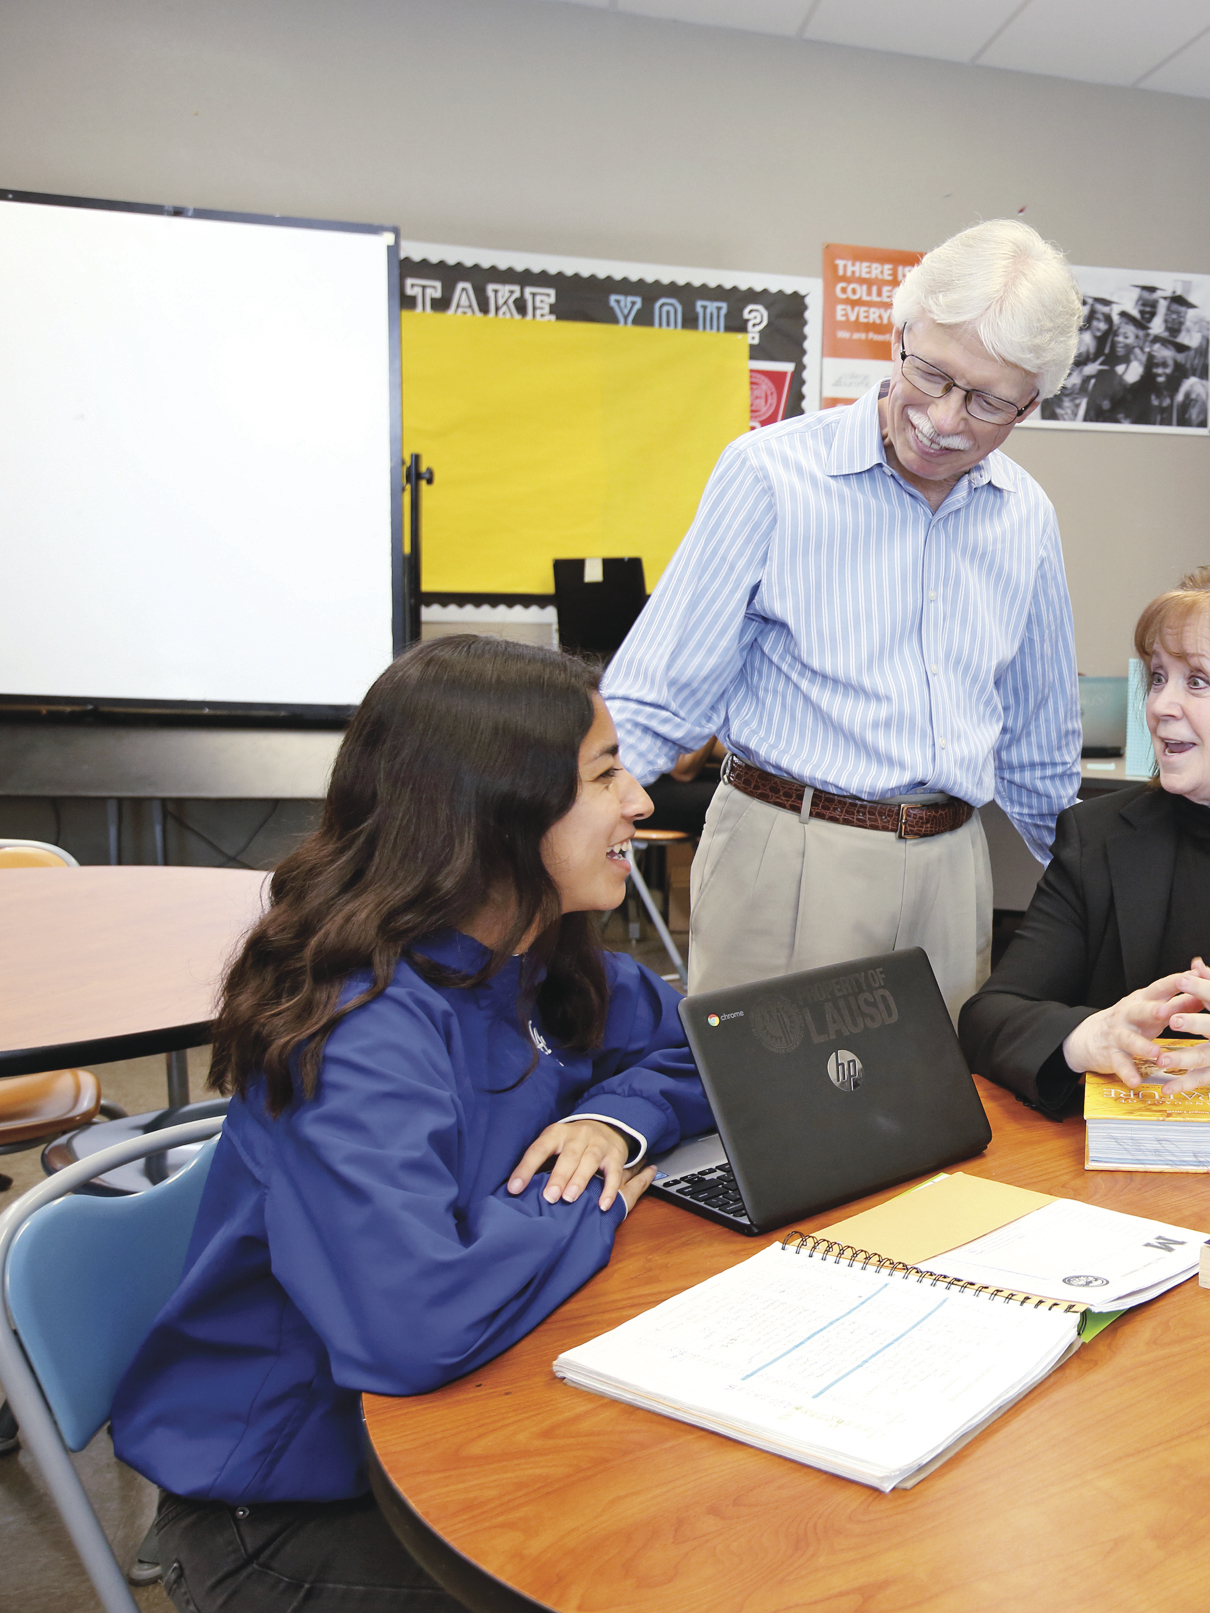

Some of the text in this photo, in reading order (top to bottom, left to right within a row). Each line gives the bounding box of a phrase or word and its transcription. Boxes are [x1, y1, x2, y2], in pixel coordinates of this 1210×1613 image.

[835, 259, 893, 280] THERE
[405, 278, 556, 322] TAKE
[836, 283, 897, 302] COLLE
[836, 304, 895, 325] EVERY
[795, 967, 888, 1005] PROPERTY OF
[720, 1010, 744, 1022] chrome
[802, 986, 900, 1045] LAUSD
